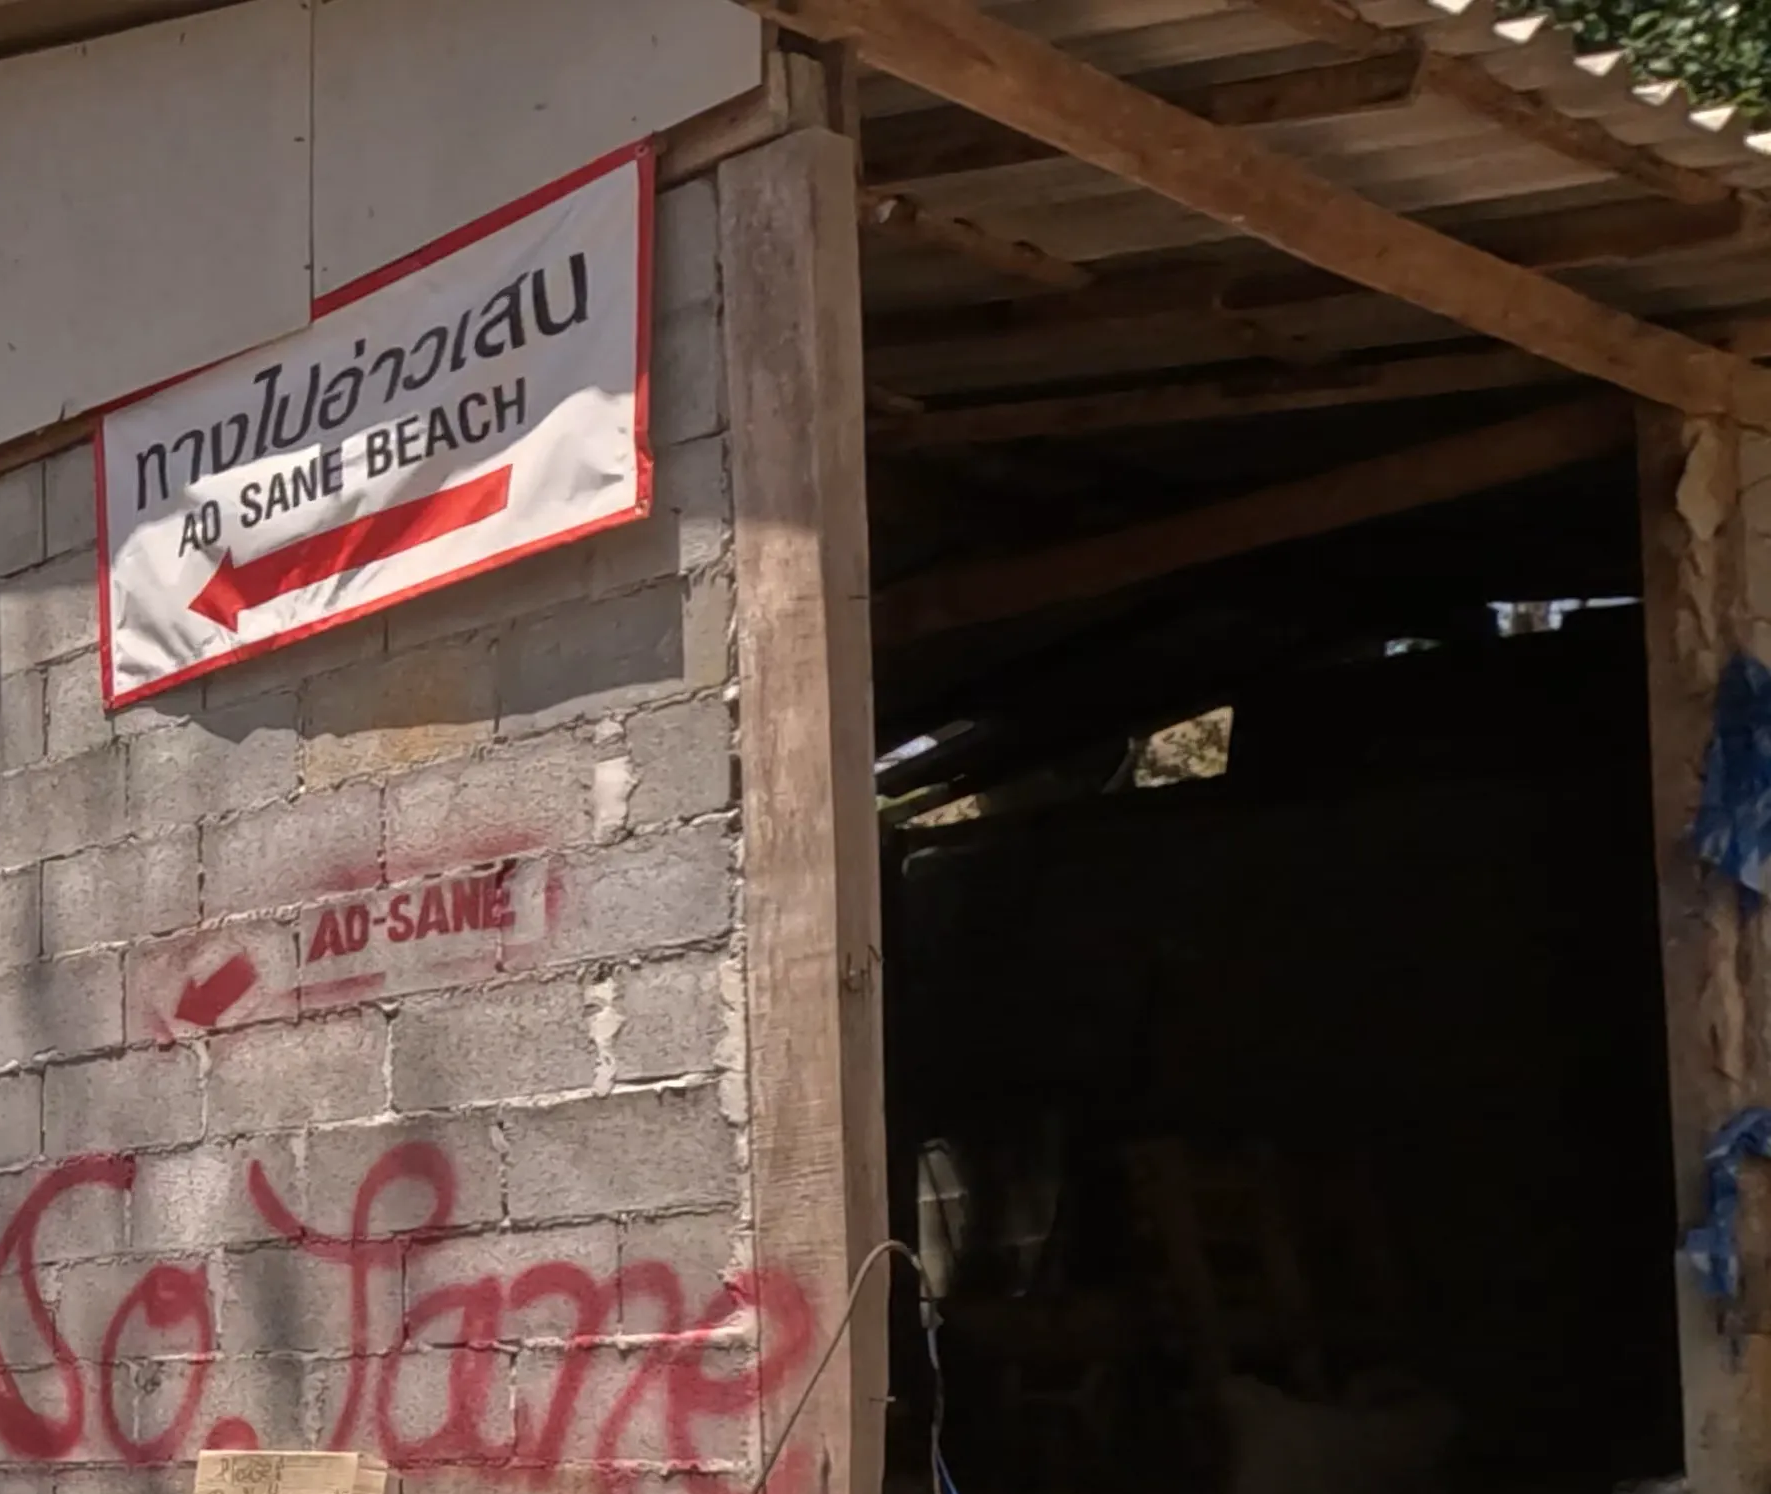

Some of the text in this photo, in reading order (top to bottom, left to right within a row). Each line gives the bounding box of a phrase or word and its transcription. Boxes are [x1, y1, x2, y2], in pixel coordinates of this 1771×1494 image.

[135, 251, 590, 511] ทางไปอ่าวเสน
[178, 377, 527, 557] AO SANE BEACH
